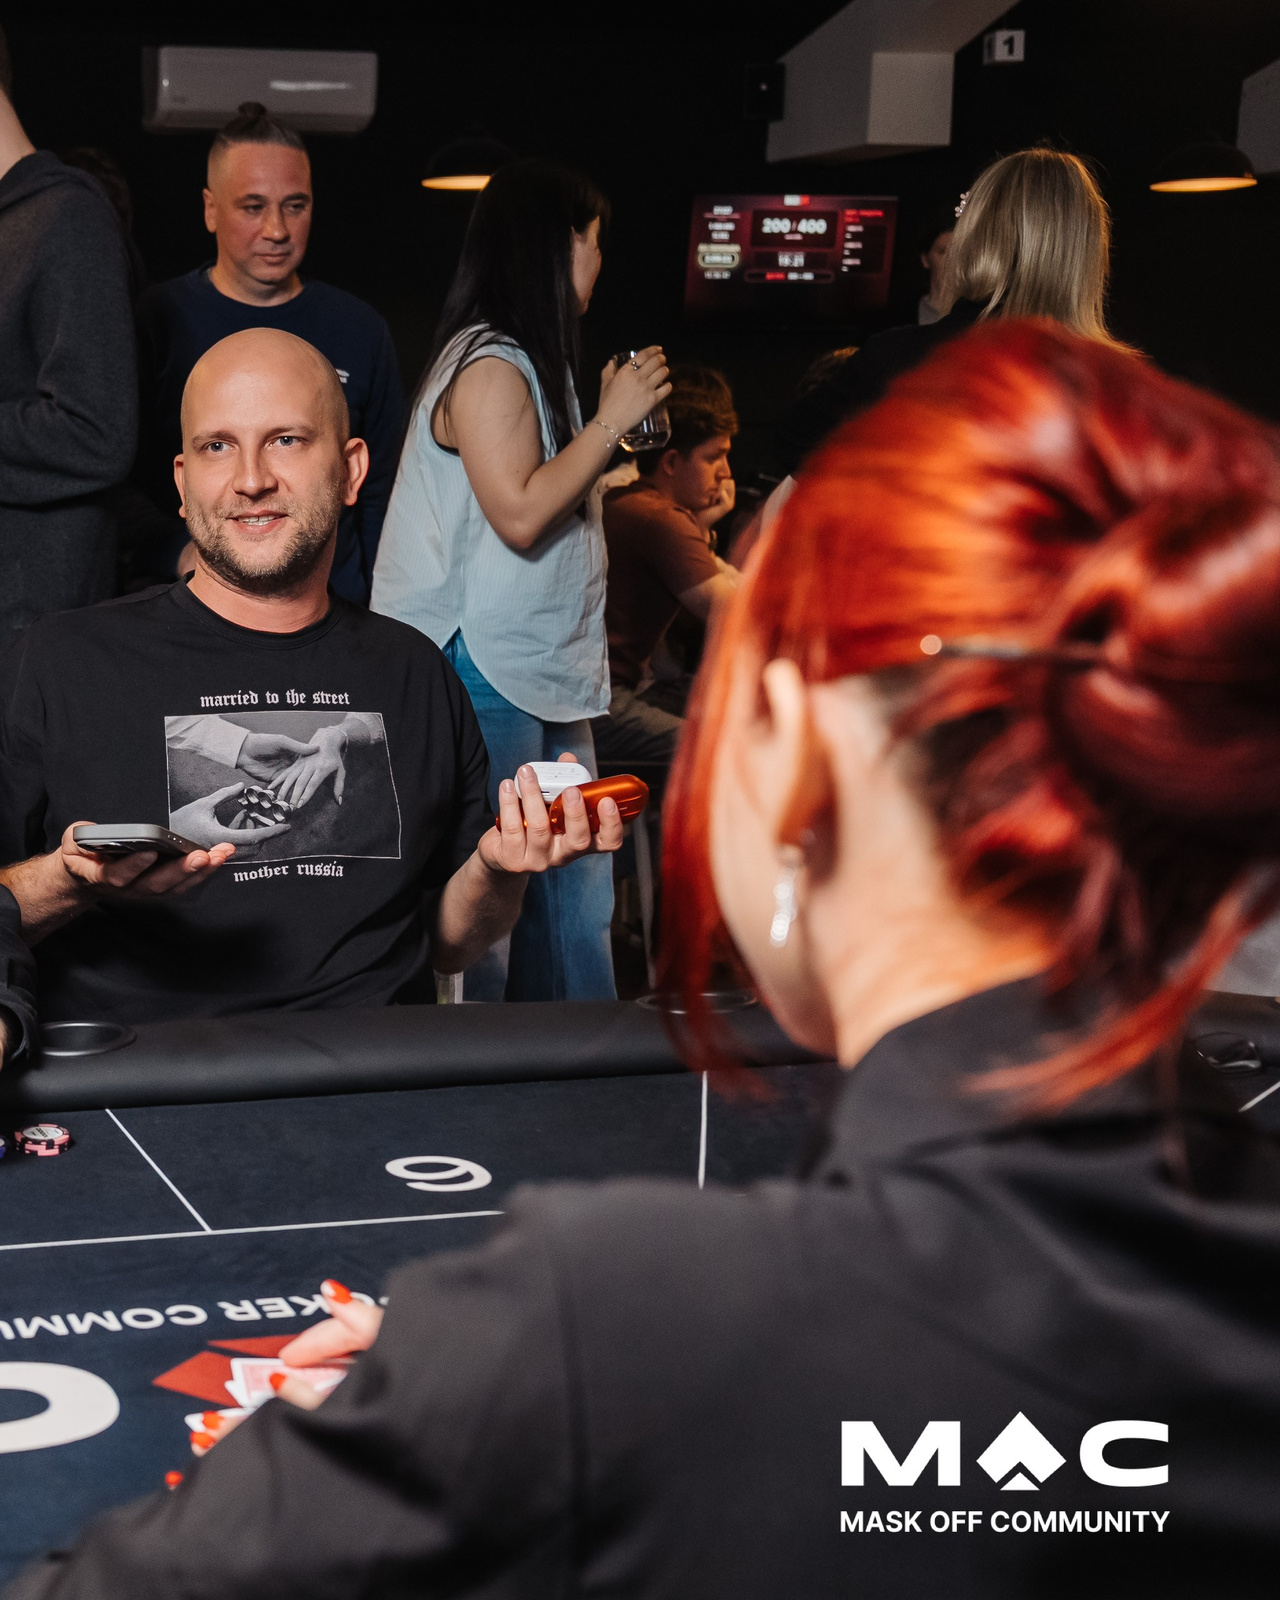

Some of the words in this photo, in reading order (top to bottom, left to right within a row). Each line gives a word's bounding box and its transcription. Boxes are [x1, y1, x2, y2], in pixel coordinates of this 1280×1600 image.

[1003, 34, 1015, 56] 1
[762, 218, 791, 234] 200
[797, 219, 827, 235] 400
[200, 689, 259, 707] married
[266, 690, 279, 704] to
[286, 689, 307, 707] the
[313, 691, 350, 705] street
[233, 864, 289, 882] mother
[297, 861, 344, 877] russia
[217, 1292, 389, 1321] KER
